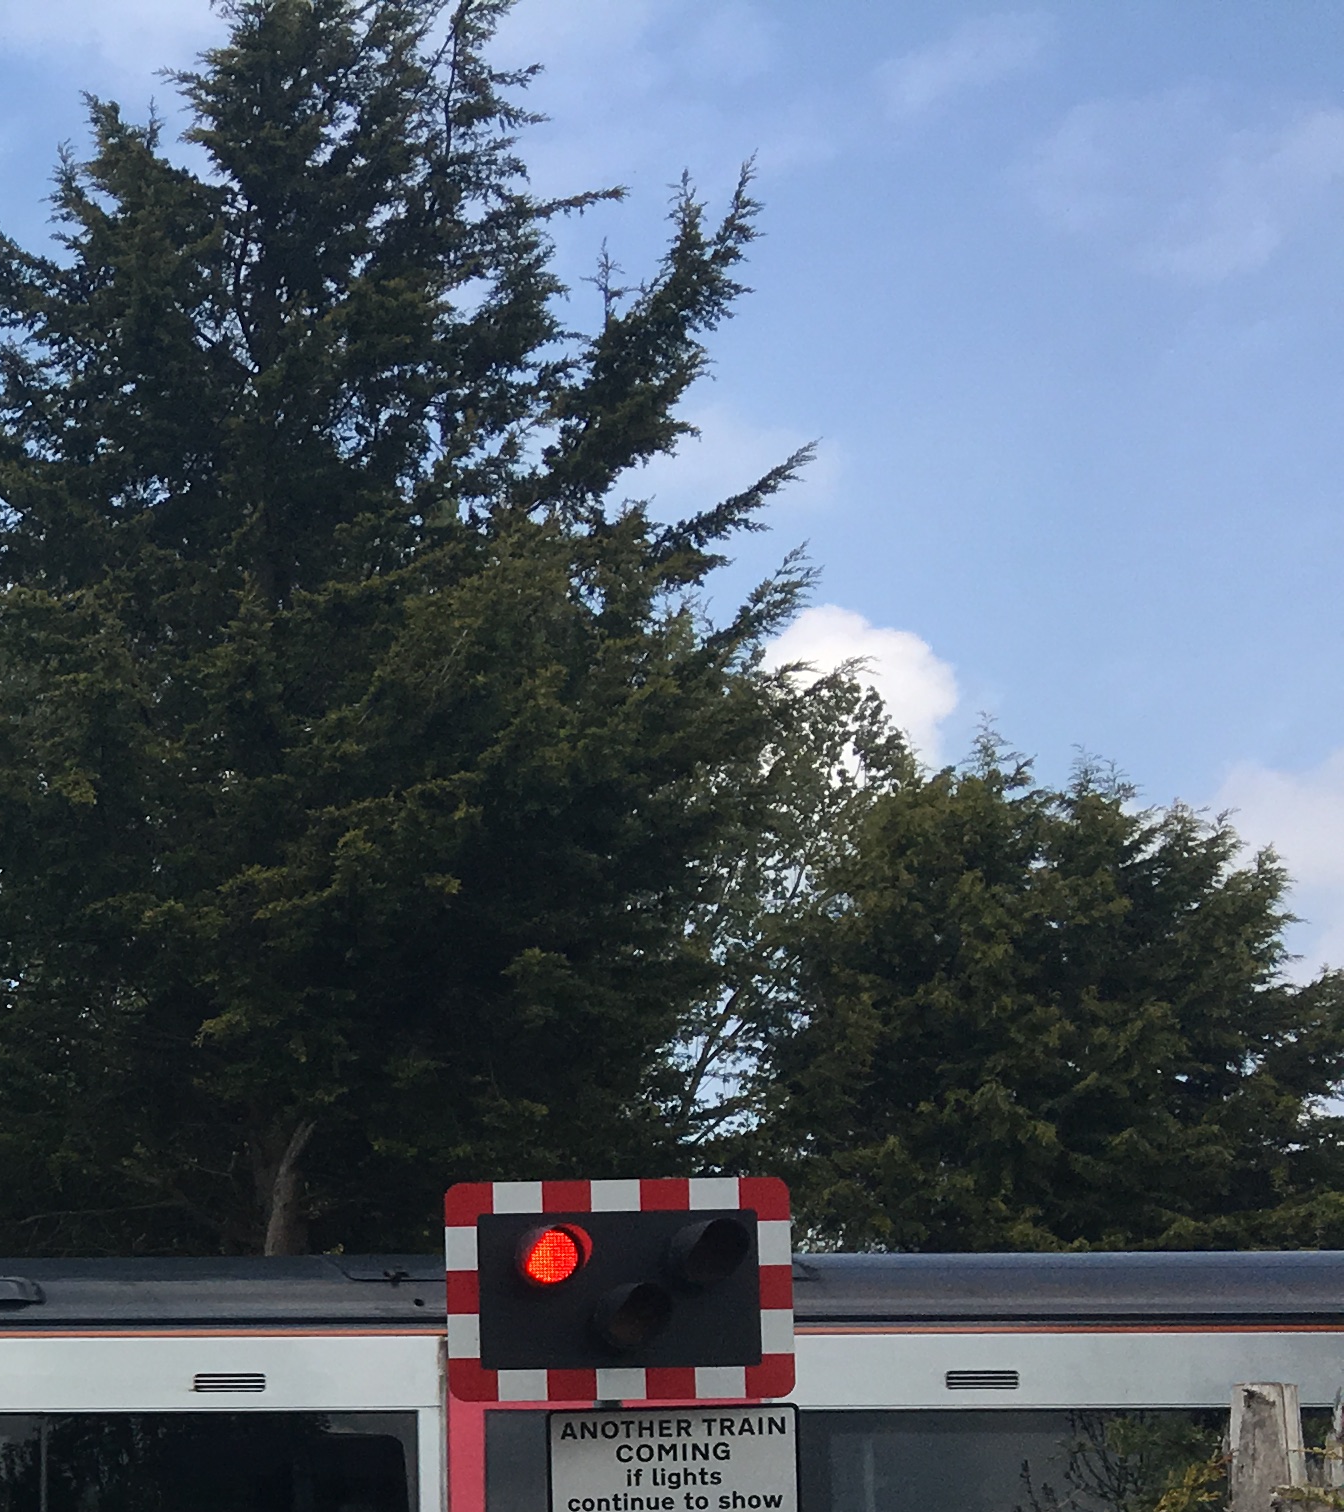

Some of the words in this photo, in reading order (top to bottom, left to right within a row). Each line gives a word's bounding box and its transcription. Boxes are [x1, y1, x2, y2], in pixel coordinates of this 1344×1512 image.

[560, 1419, 692, 1440] ANOTHER
[702, 1416, 786, 1436] TRAIN
[616, 1442, 731, 1463] COMING
[626, 1468, 643, 1486] if
[652, 1467, 722, 1489] lights
[567, 1493, 675, 1512] continue
[684, 1492, 709, 1510] to
[718, 1491, 783, 1509] show
